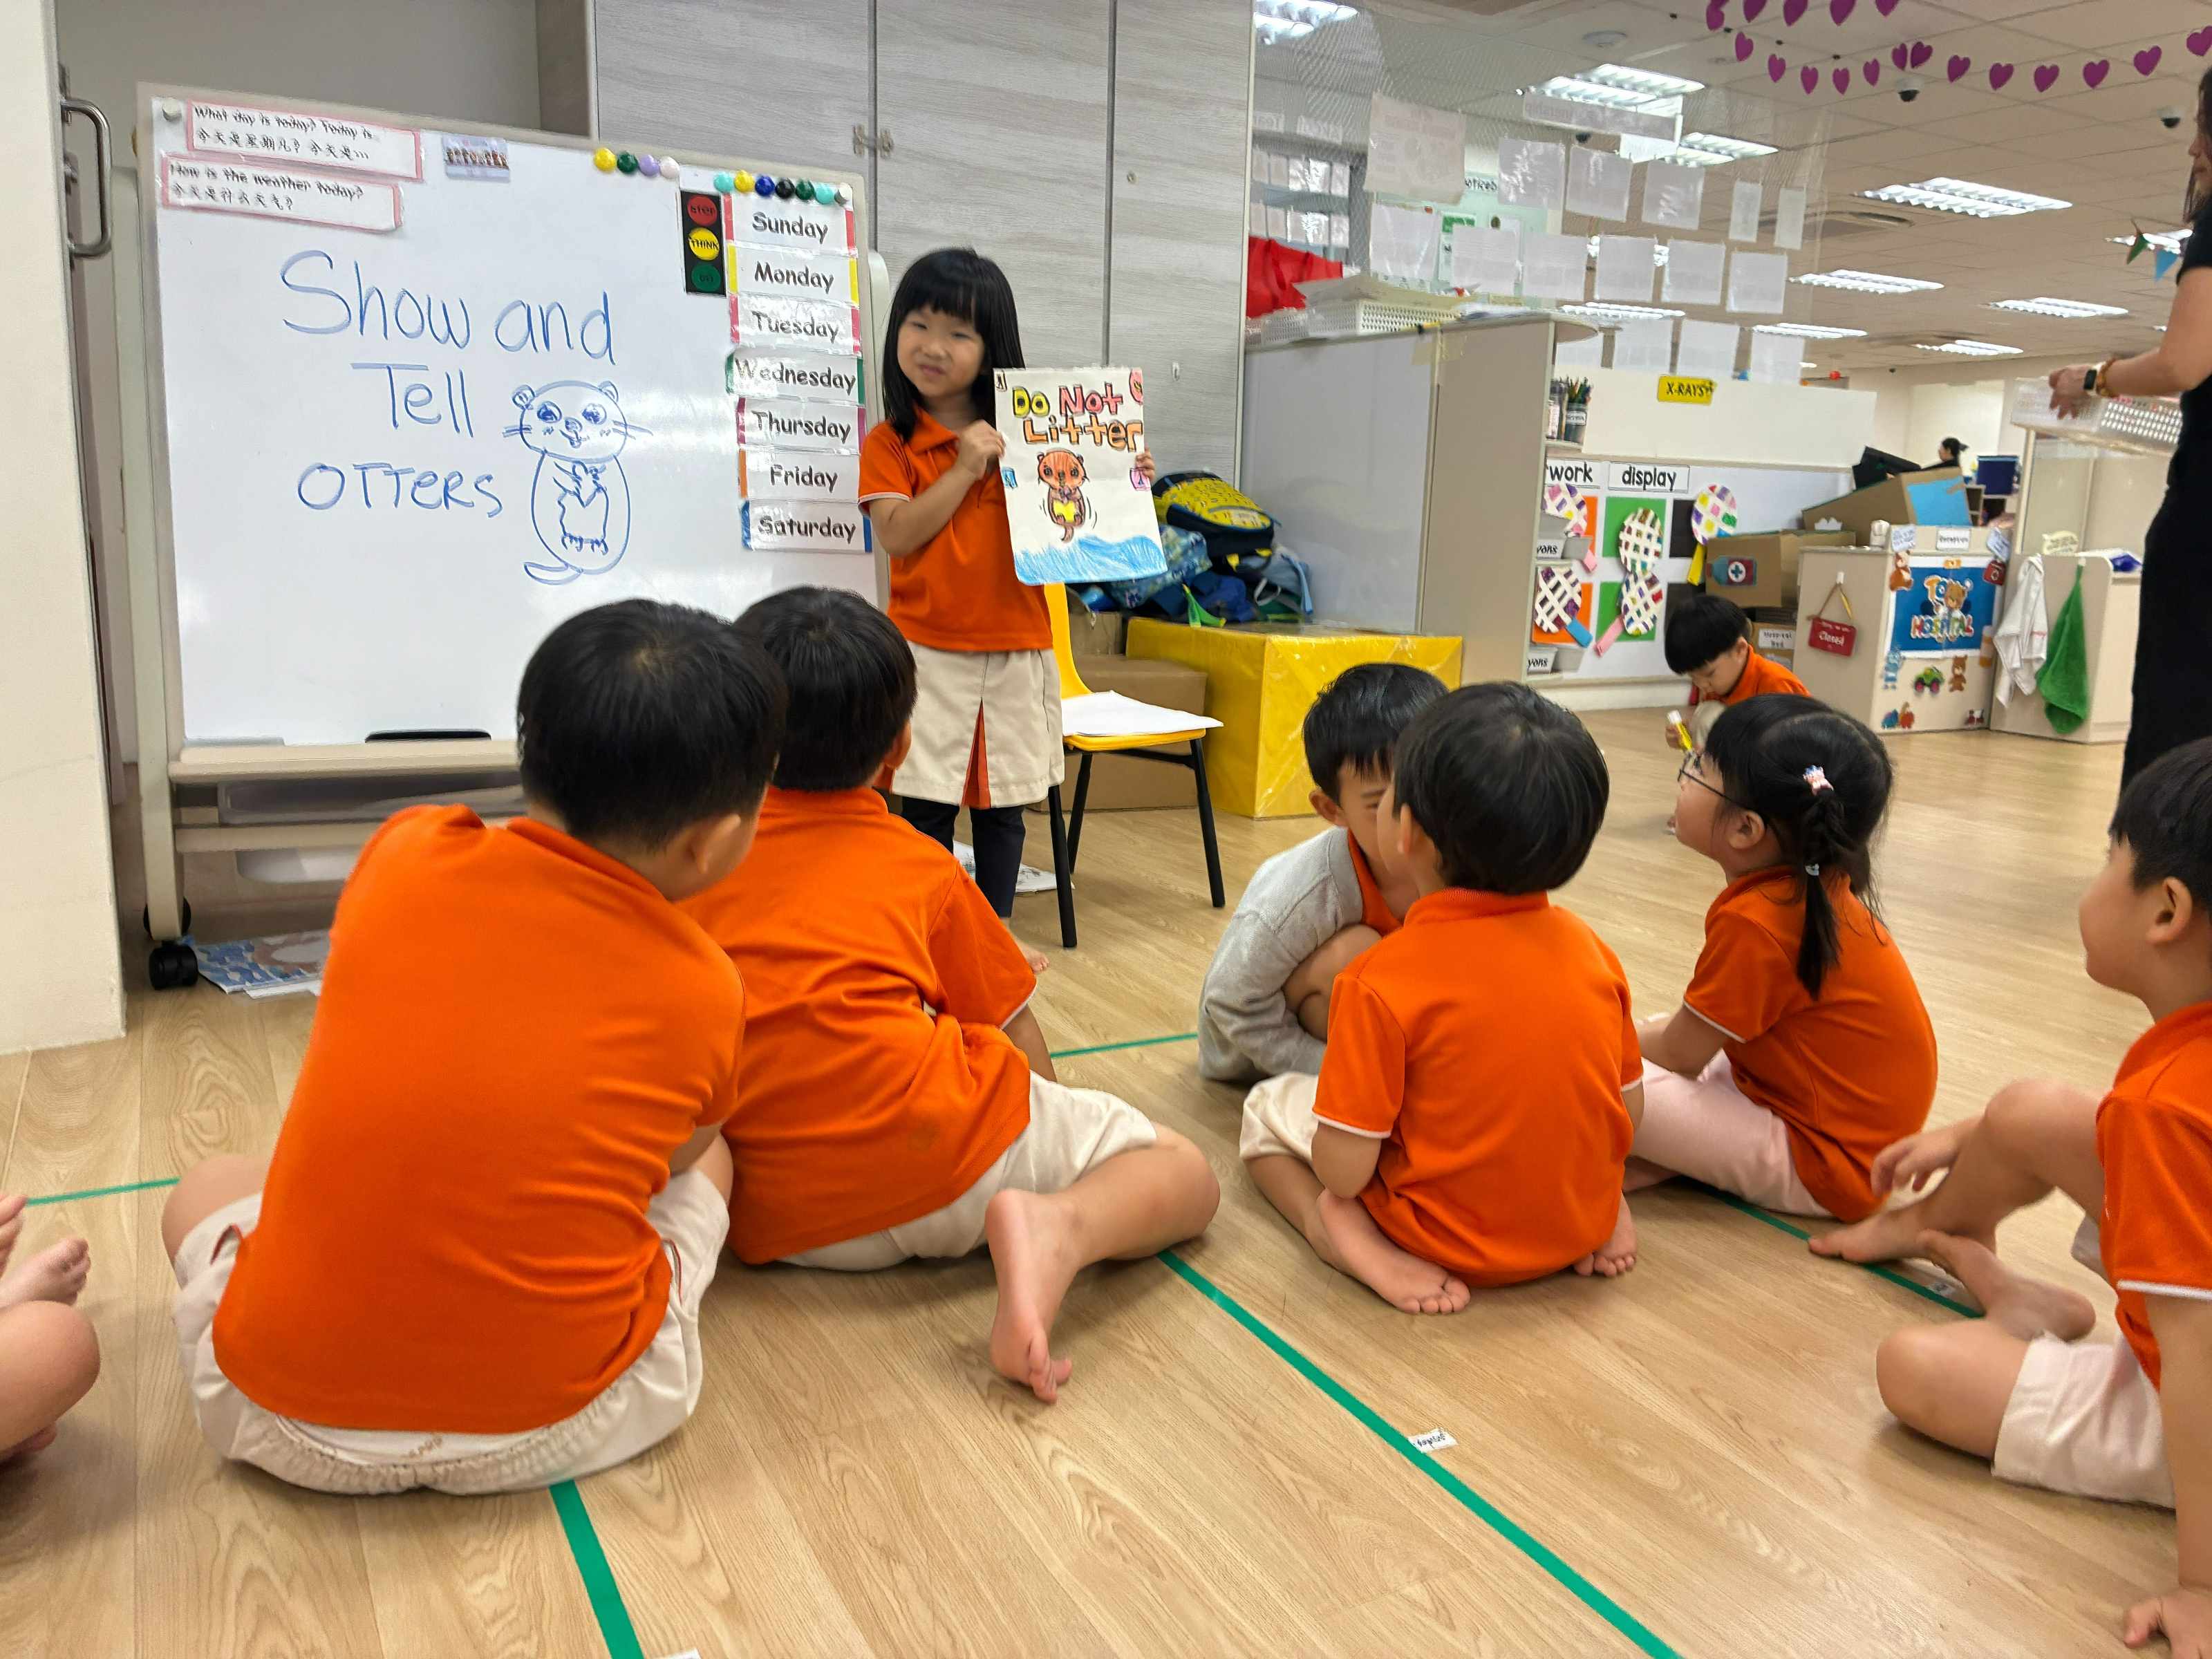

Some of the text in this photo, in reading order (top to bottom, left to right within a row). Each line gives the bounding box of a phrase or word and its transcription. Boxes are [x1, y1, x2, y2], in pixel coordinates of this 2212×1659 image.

[691, 238, 719, 250] THINK
[752, 212, 828, 244] Sunday
[754, 261, 835, 293] Monday
[280, 250, 616, 366] Show and
[753, 311, 840, 341] Tuesday
[735, 357, 856, 395] Wednesday
[350, 362, 474, 438] Tell
[1013, 382, 1123, 418] Do Not
[751, 411, 851, 443] Thursday
[1023, 414, 1143, 453] Litter
[769, 464, 838, 493] Friday
[1549, 462, 1676, 491] work display
[758, 514, 856, 543] Saturday
